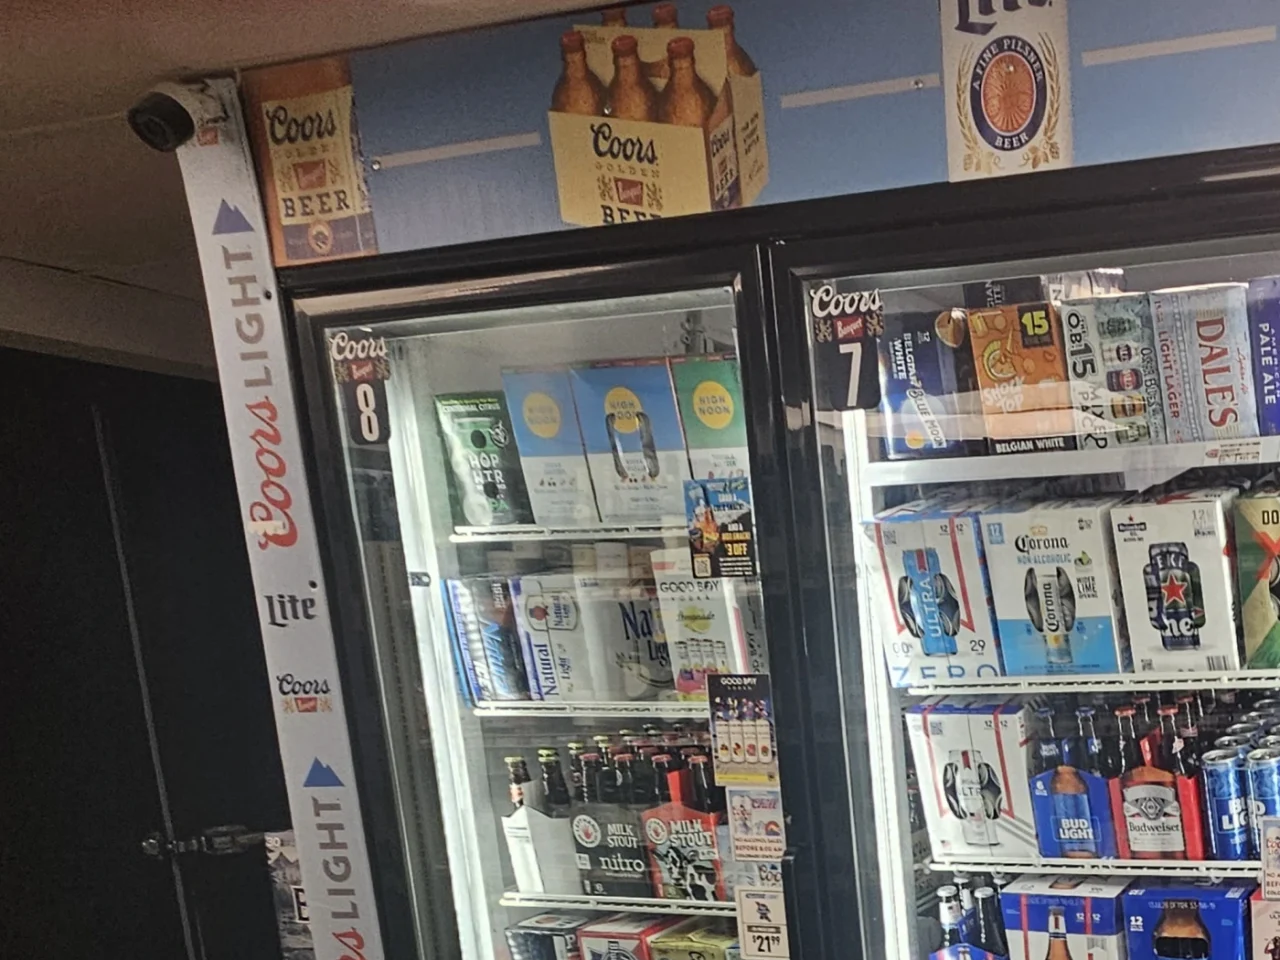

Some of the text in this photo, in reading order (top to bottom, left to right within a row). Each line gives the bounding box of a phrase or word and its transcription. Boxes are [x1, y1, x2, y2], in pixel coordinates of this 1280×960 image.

[977, 43, 1000, 75] FINE
[1003, 38, 1045, 83] PILSNER
[266, 106, 337, 145] Coors
[590, 122, 659, 166] Coors
[281, 189, 350, 218] BEER
[810, 285, 884, 317] Coors
[1021, 310, 1049, 336] 15
[331, 332, 388, 361] Coors
[839, 342, 862, 407] 7
[1195, 316, 1239, 428] DALE'S
[1258, 322, 1277, 405] PALE ALE
[222, 244, 300, 551] LIGHT Coors
[357, 383, 379, 442] 8
[996, 437, 1066, 454] BELGIAN WHITE
[468, 452, 500, 469] HOP
[473, 470, 504, 486] WTR
[1015, 535, 1069, 554] Corona
[263, 593, 317, 629] Lite
[922, 577, 941, 638] ULTRA
[276, 672, 331, 697] Coors
[607, 824, 633, 836] MILK
[670, 819, 704, 833] MILK
[1059, 827, 1094, 840] LIGHT
[1062, 818, 1089, 829] BUD
[1129, 822, 1180, 833] Budweiser
[606, 836, 638, 849] STOUT
[668, 831, 713, 848] STOUT
[311, 795, 359, 920] LIGHT
[599, 852, 645, 873] nitro
